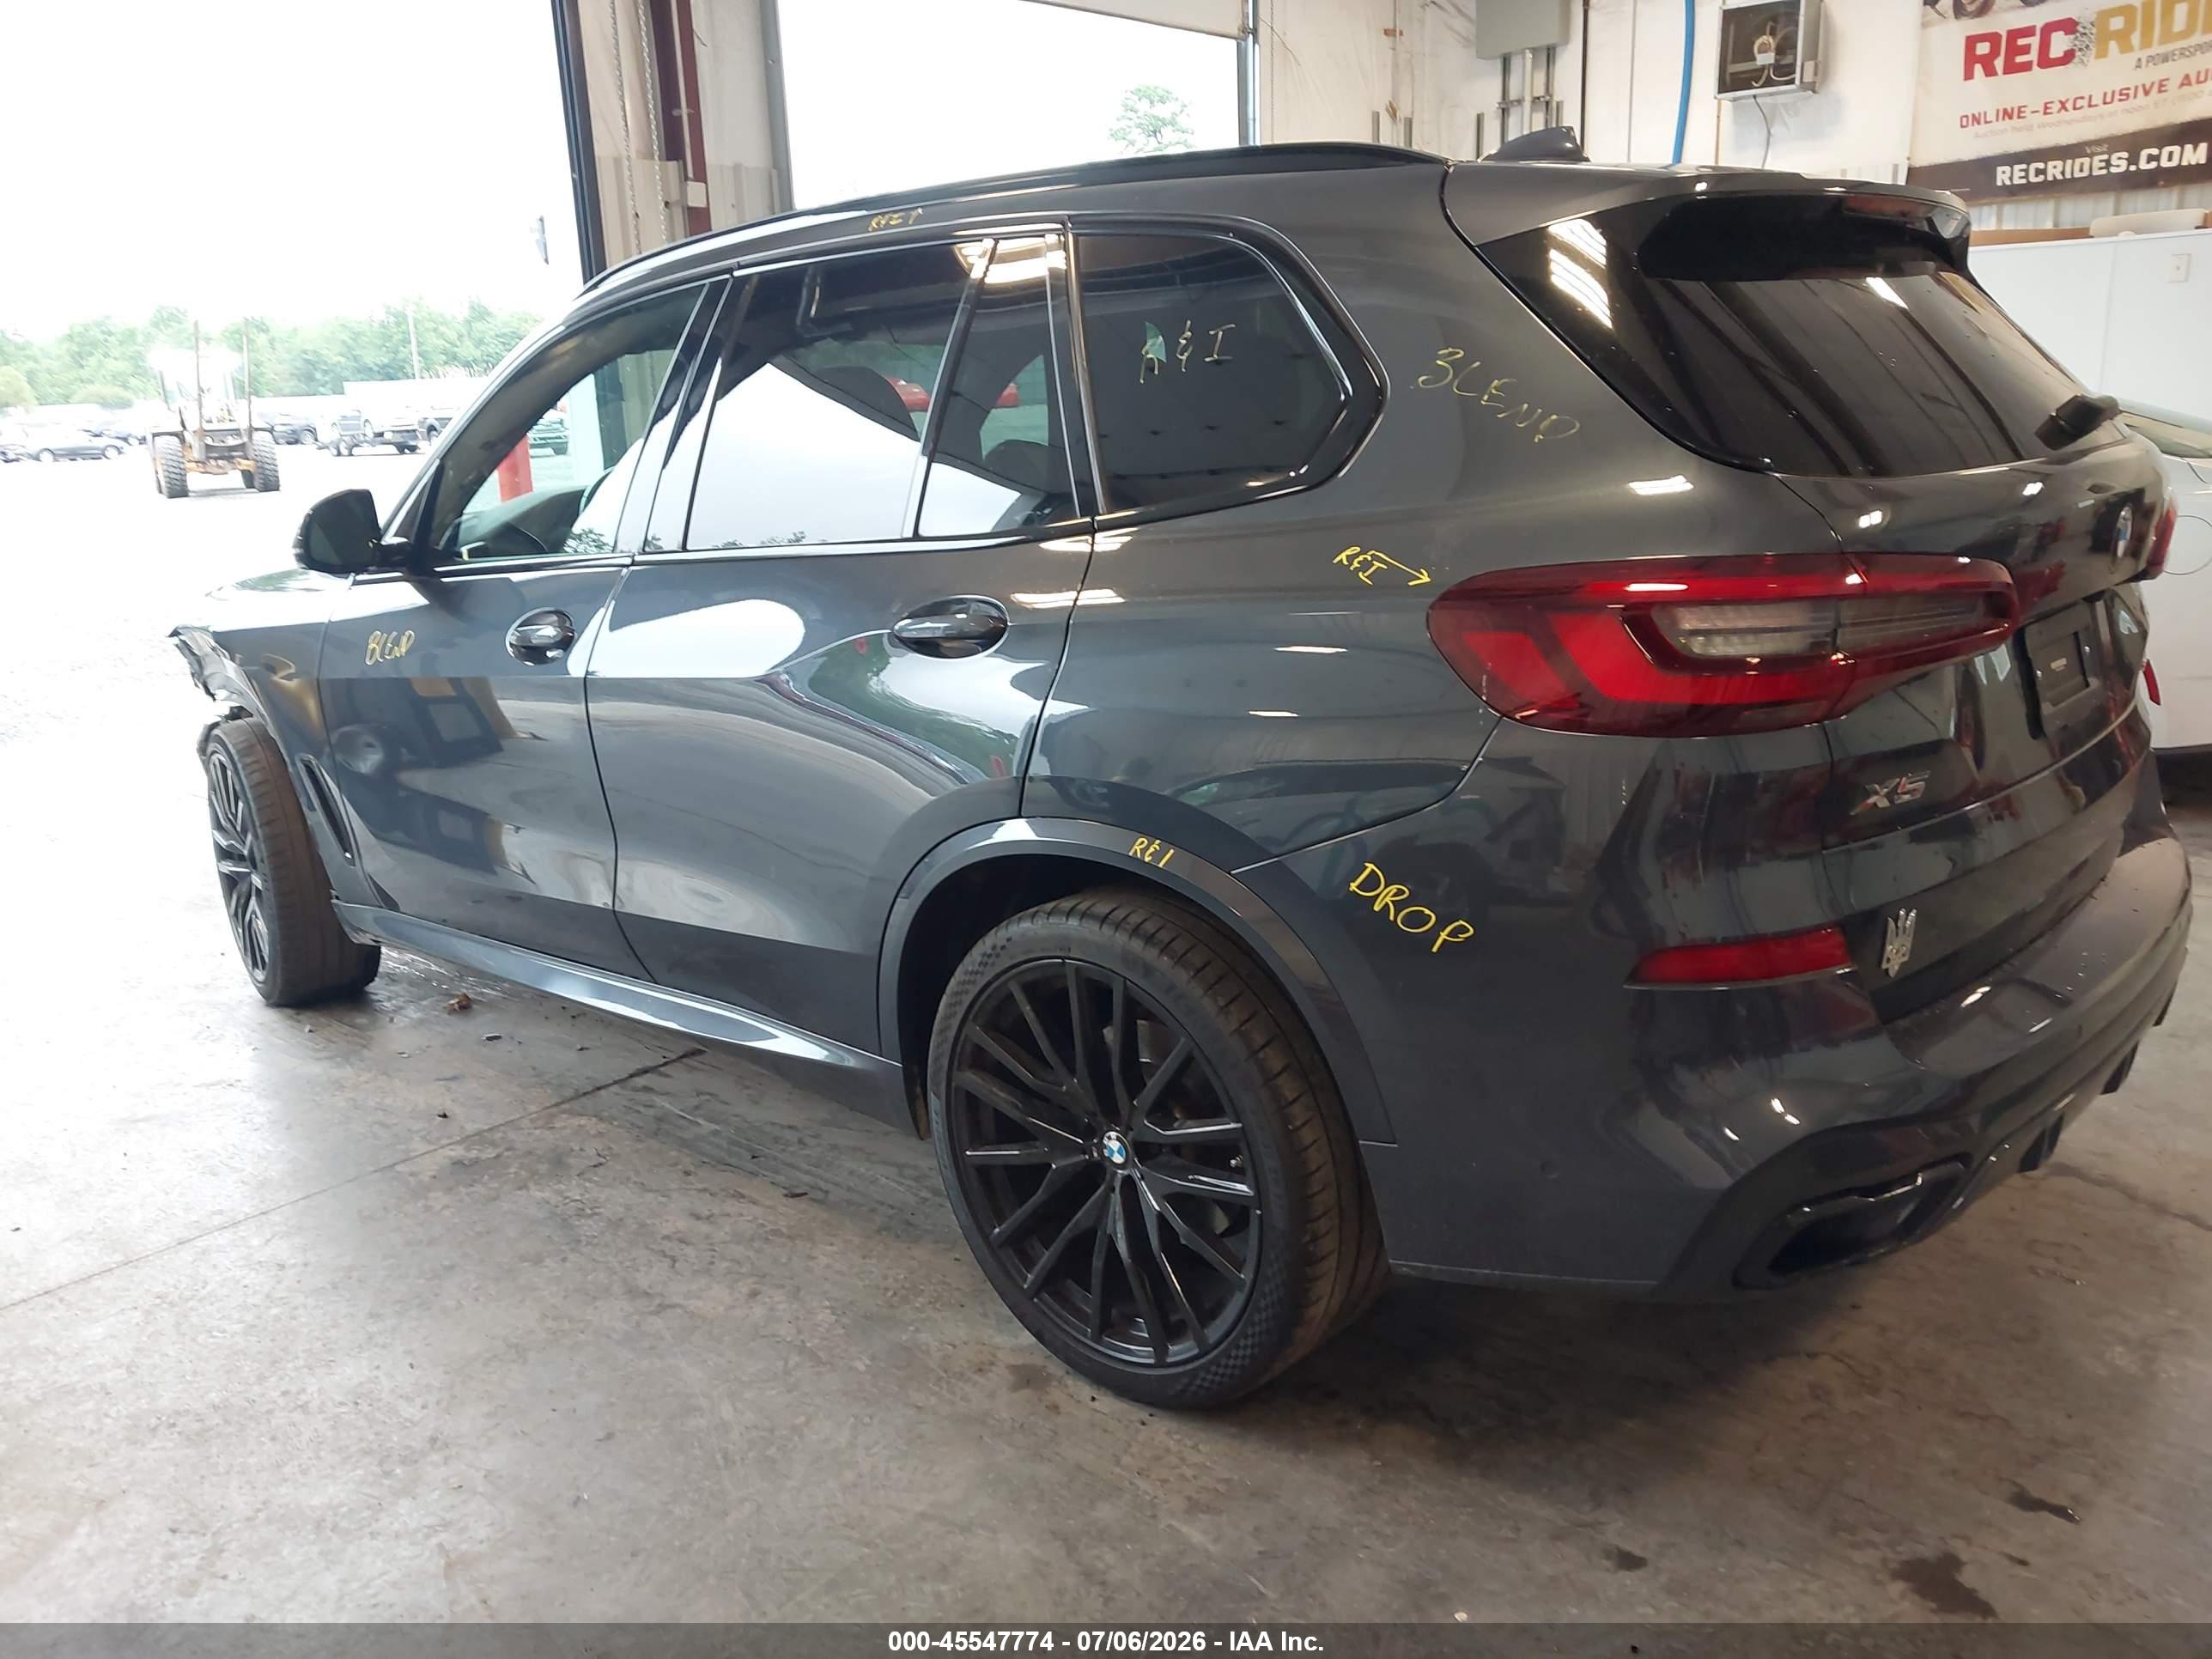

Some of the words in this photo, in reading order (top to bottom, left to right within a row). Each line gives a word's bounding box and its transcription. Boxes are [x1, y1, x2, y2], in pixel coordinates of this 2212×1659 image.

[1963, 16, 2080, 81] REC
[2134, 57, 2143, 70] A
[1960, 77, 2171, 129] ONLINE-EXCLUSIVE
[2178, 65, 2212, 89] AU
[1995, 142, 2209, 186] RECRIDES.COM
[1849, 771, 1931, 816] X5
[1349, 862, 1475, 953] DROP
